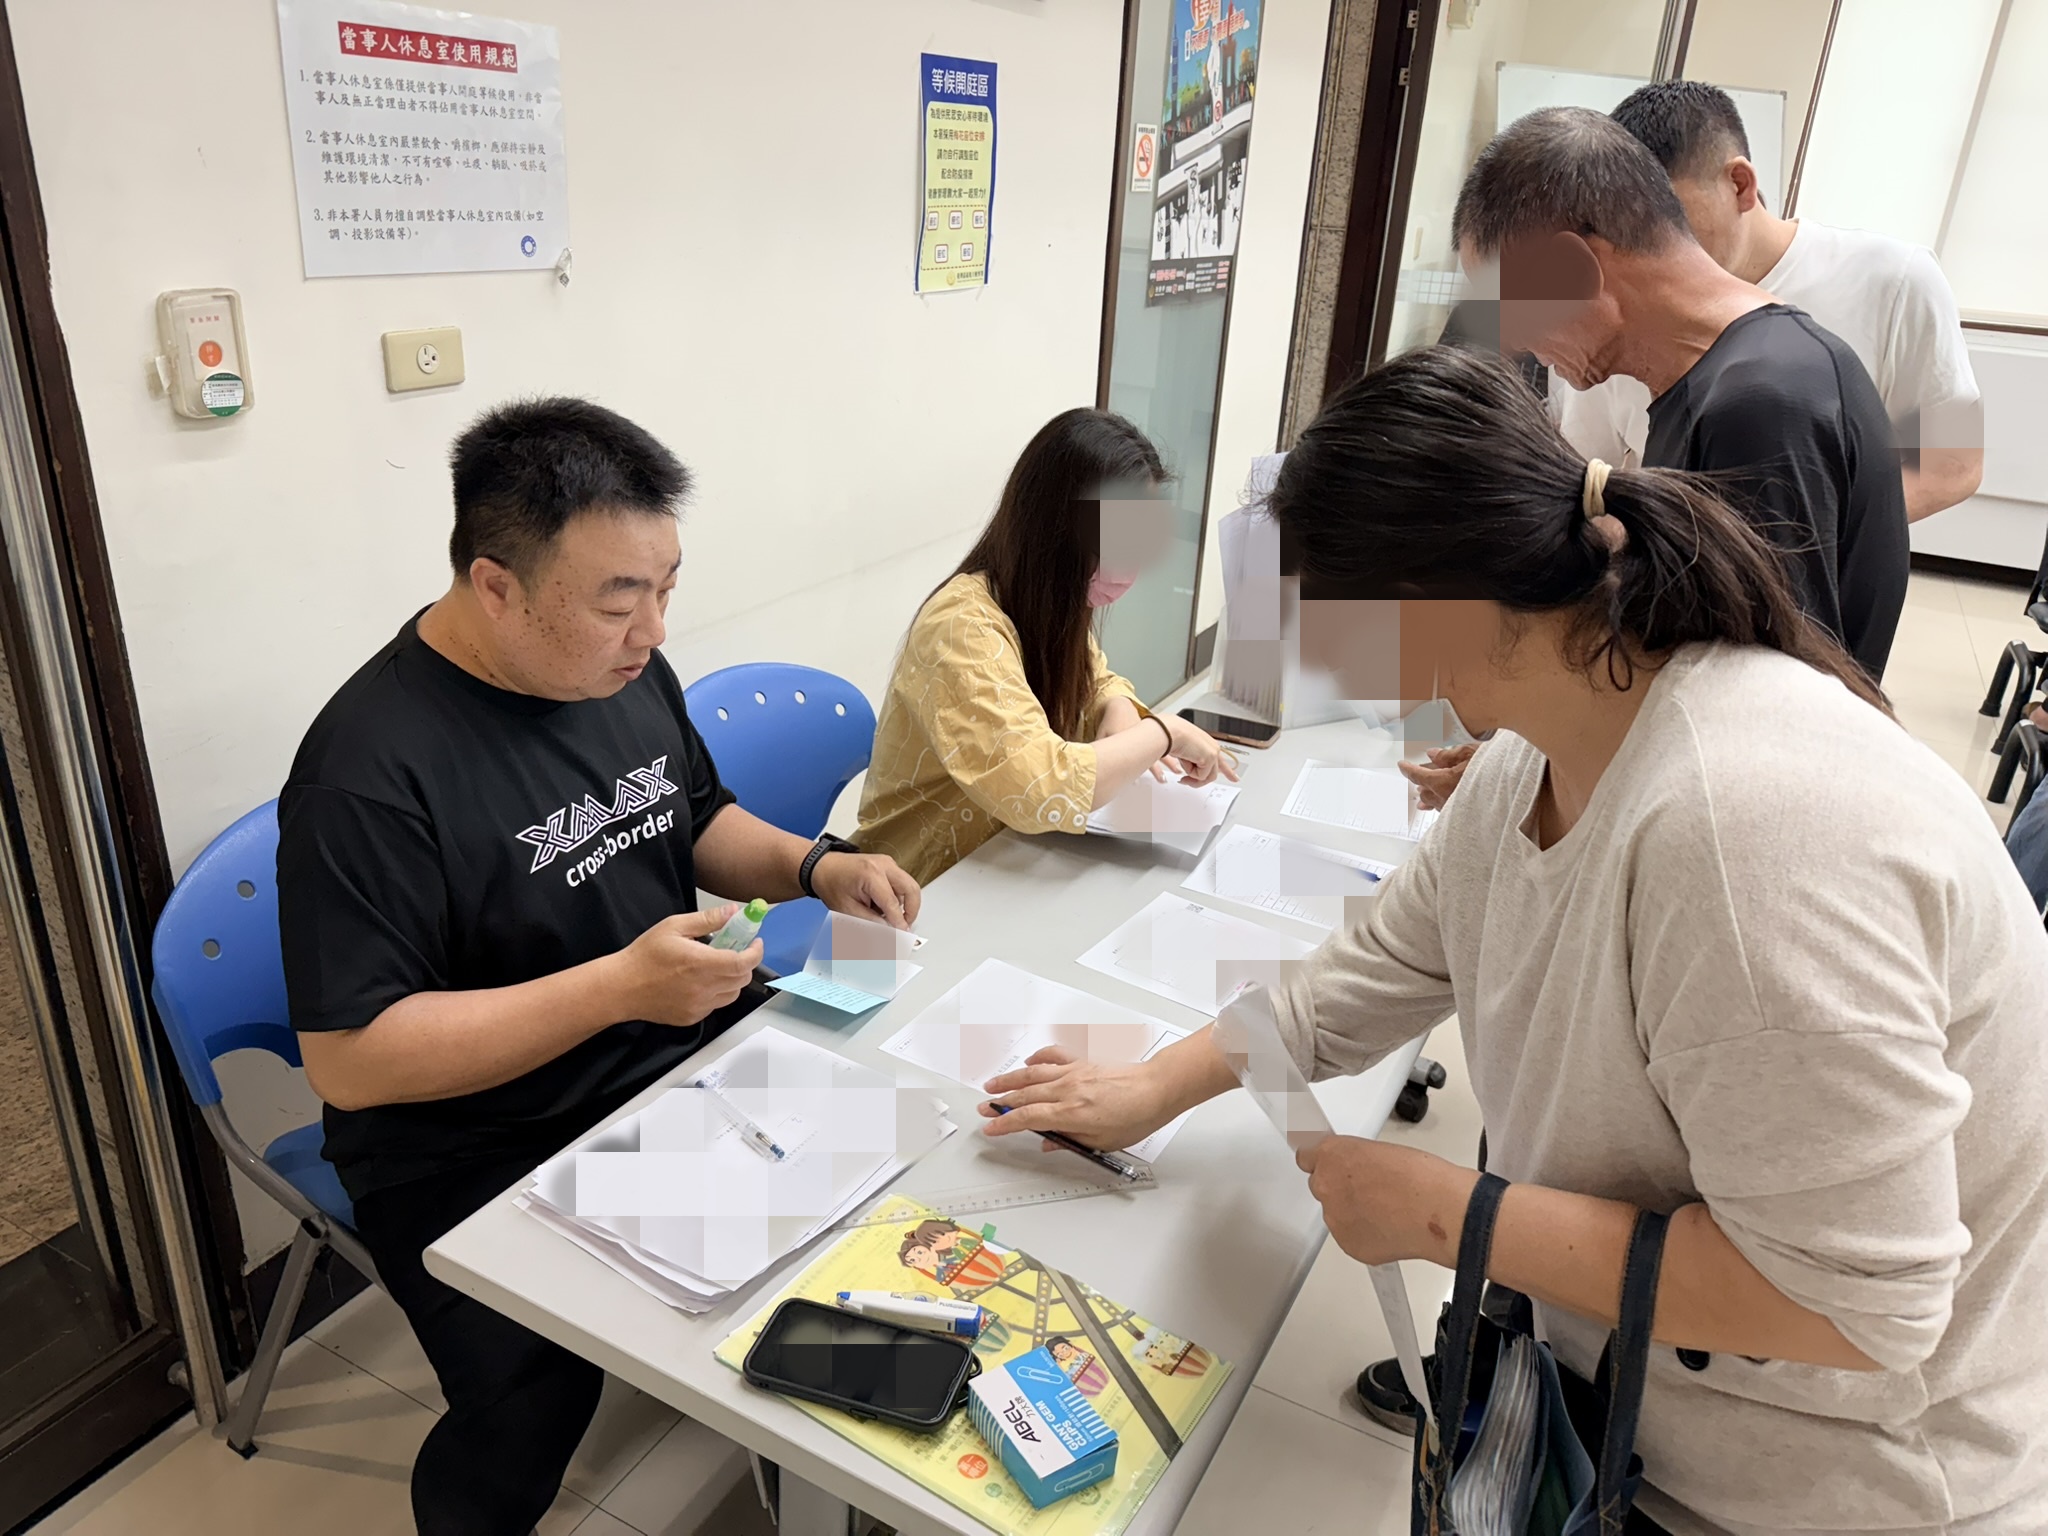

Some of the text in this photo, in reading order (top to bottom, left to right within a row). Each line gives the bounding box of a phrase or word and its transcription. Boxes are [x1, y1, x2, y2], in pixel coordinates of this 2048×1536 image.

[341, 26, 517, 68] 當事人休息室使用規範
[299, 69, 310, 82] 1.
[931, 68, 989, 97] 等候開庭區
[305, 129, 317, 144] 2.
[324, 170, 431, 186] 其他影響他人之行為。
[314, 208, 324, 221] 3.
[515, 755, 679, 874] XMAX
[566, 809, 674, 887] cross-border
[1015, 1396, 1035, 1418] 力大牌
[1003, 1400, 1041, 1442] ABEL
[1035, 1400, 1079, 1450] GIANT GEM
[1062, 1420, 1087, 1446] CLIPS
